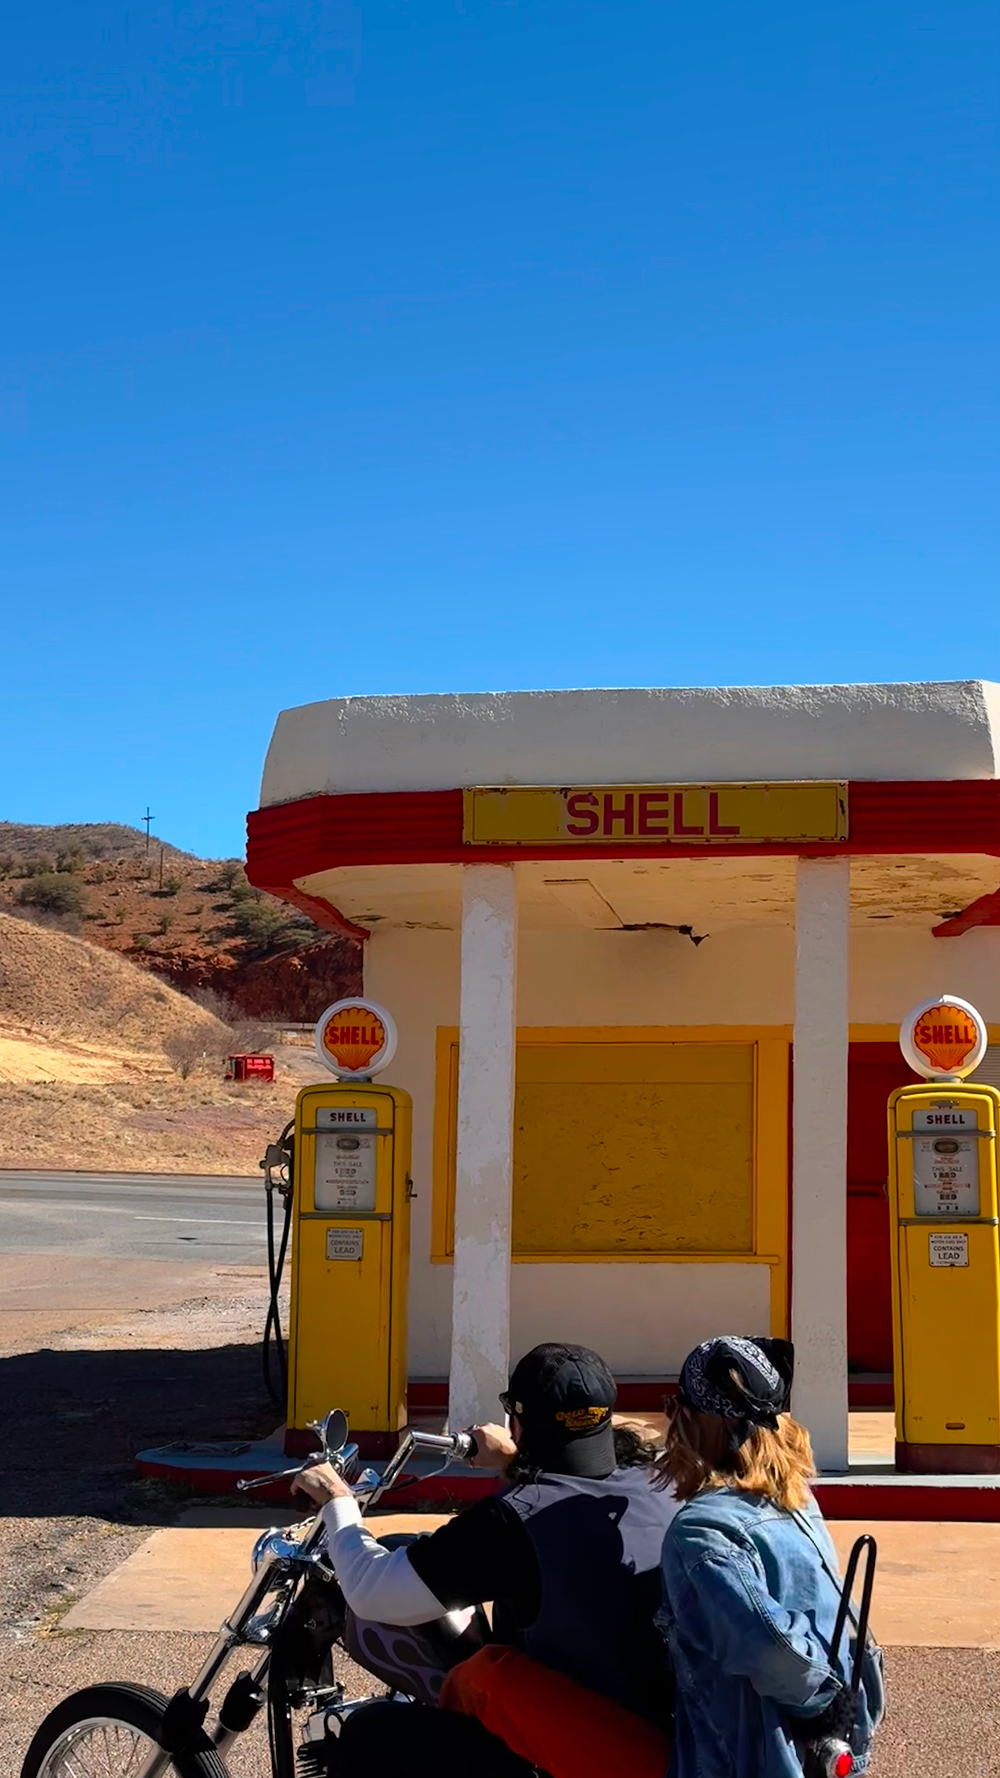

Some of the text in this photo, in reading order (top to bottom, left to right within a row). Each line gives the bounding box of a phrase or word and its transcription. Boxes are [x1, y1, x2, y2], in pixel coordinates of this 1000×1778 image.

[566, 791, 740, 836] SHELL
[328, 1026, 379, 1045] SHELL
[920, 1025, 972, 1044] SHELL
[329, 1112, 366, 1122] SHELL
[926, 1114, 966, 1125] SHELL
[334, 1246, 355, 1254] LEAD
[938, 1252, 960, 1260] LEAD
